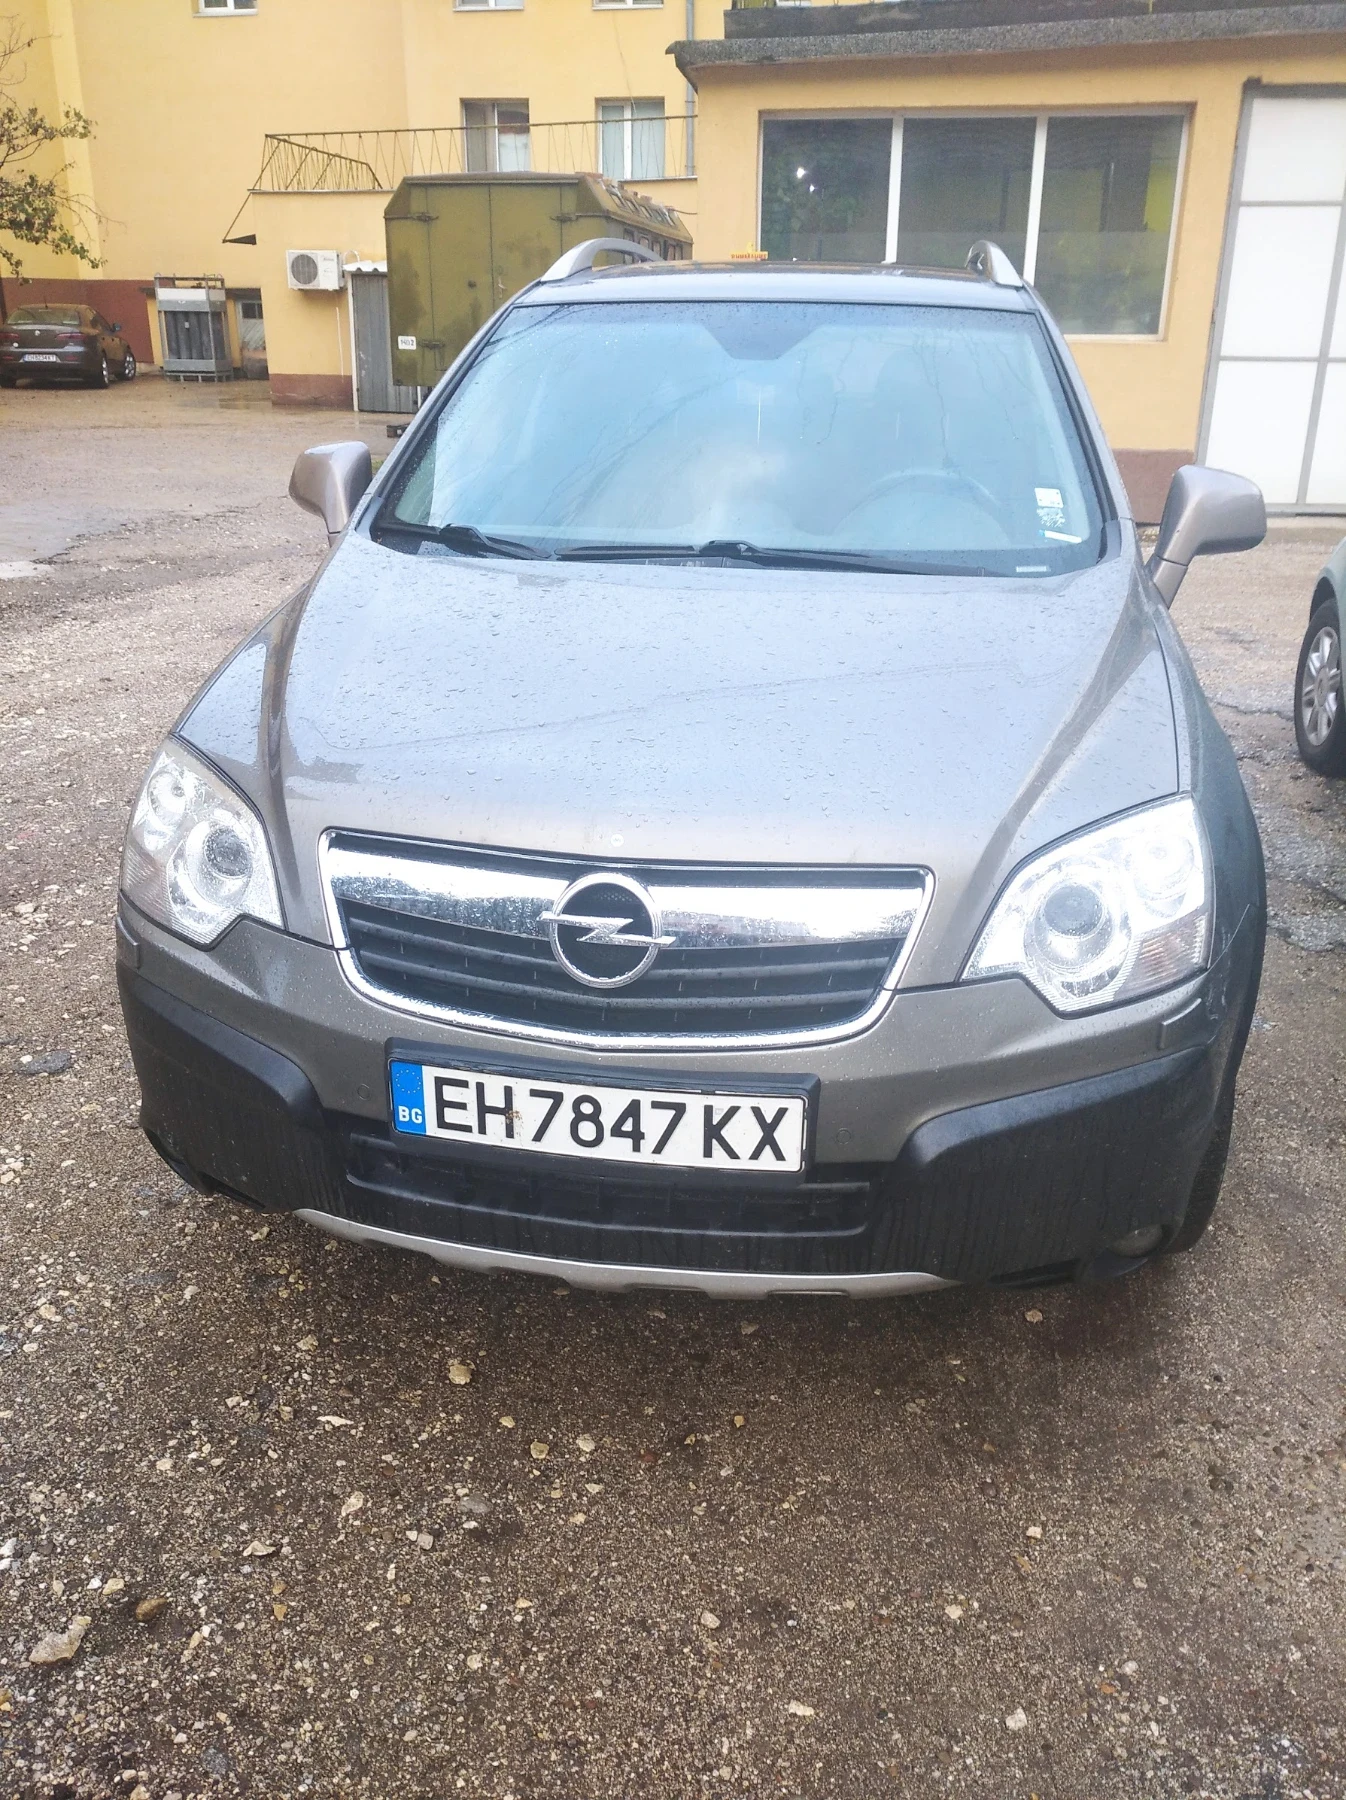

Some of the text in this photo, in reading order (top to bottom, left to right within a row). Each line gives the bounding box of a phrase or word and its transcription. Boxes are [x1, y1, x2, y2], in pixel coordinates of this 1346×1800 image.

[398, 1076, 789, 1162] BG EH 7847 KX
